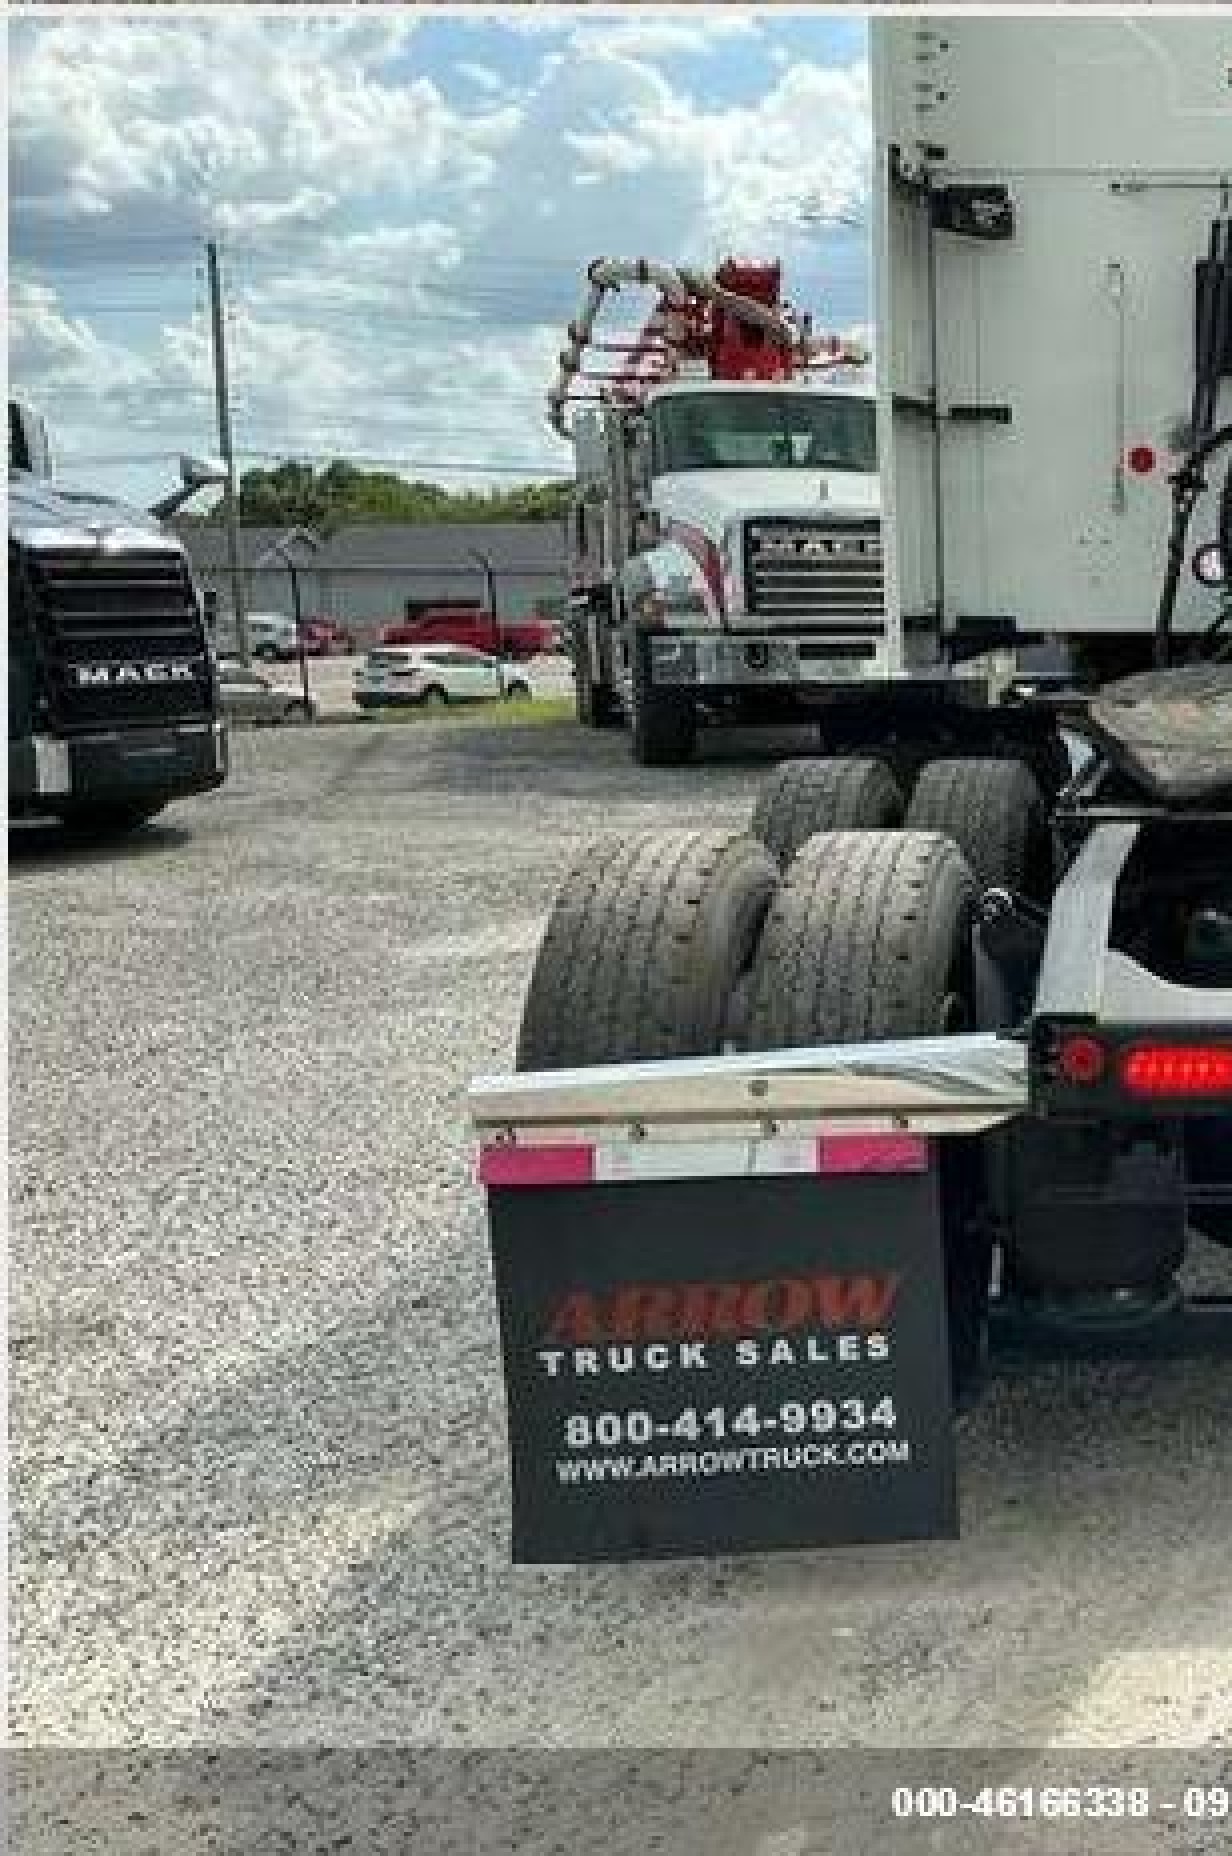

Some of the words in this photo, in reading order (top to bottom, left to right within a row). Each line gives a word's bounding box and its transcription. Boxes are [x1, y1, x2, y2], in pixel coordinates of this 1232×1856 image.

[78, 662, 194, 685] MACK
[546, 1273, 898, 1340] ARROW
[537, 1343, 708, 1377] TRUCK
[735, 1335, 891, 1367] SALES
[563, 1397, 897, 1449] 800-414-9934
[556, 1439, 910, 1485] WWW.ARROWTRUCK.COM
